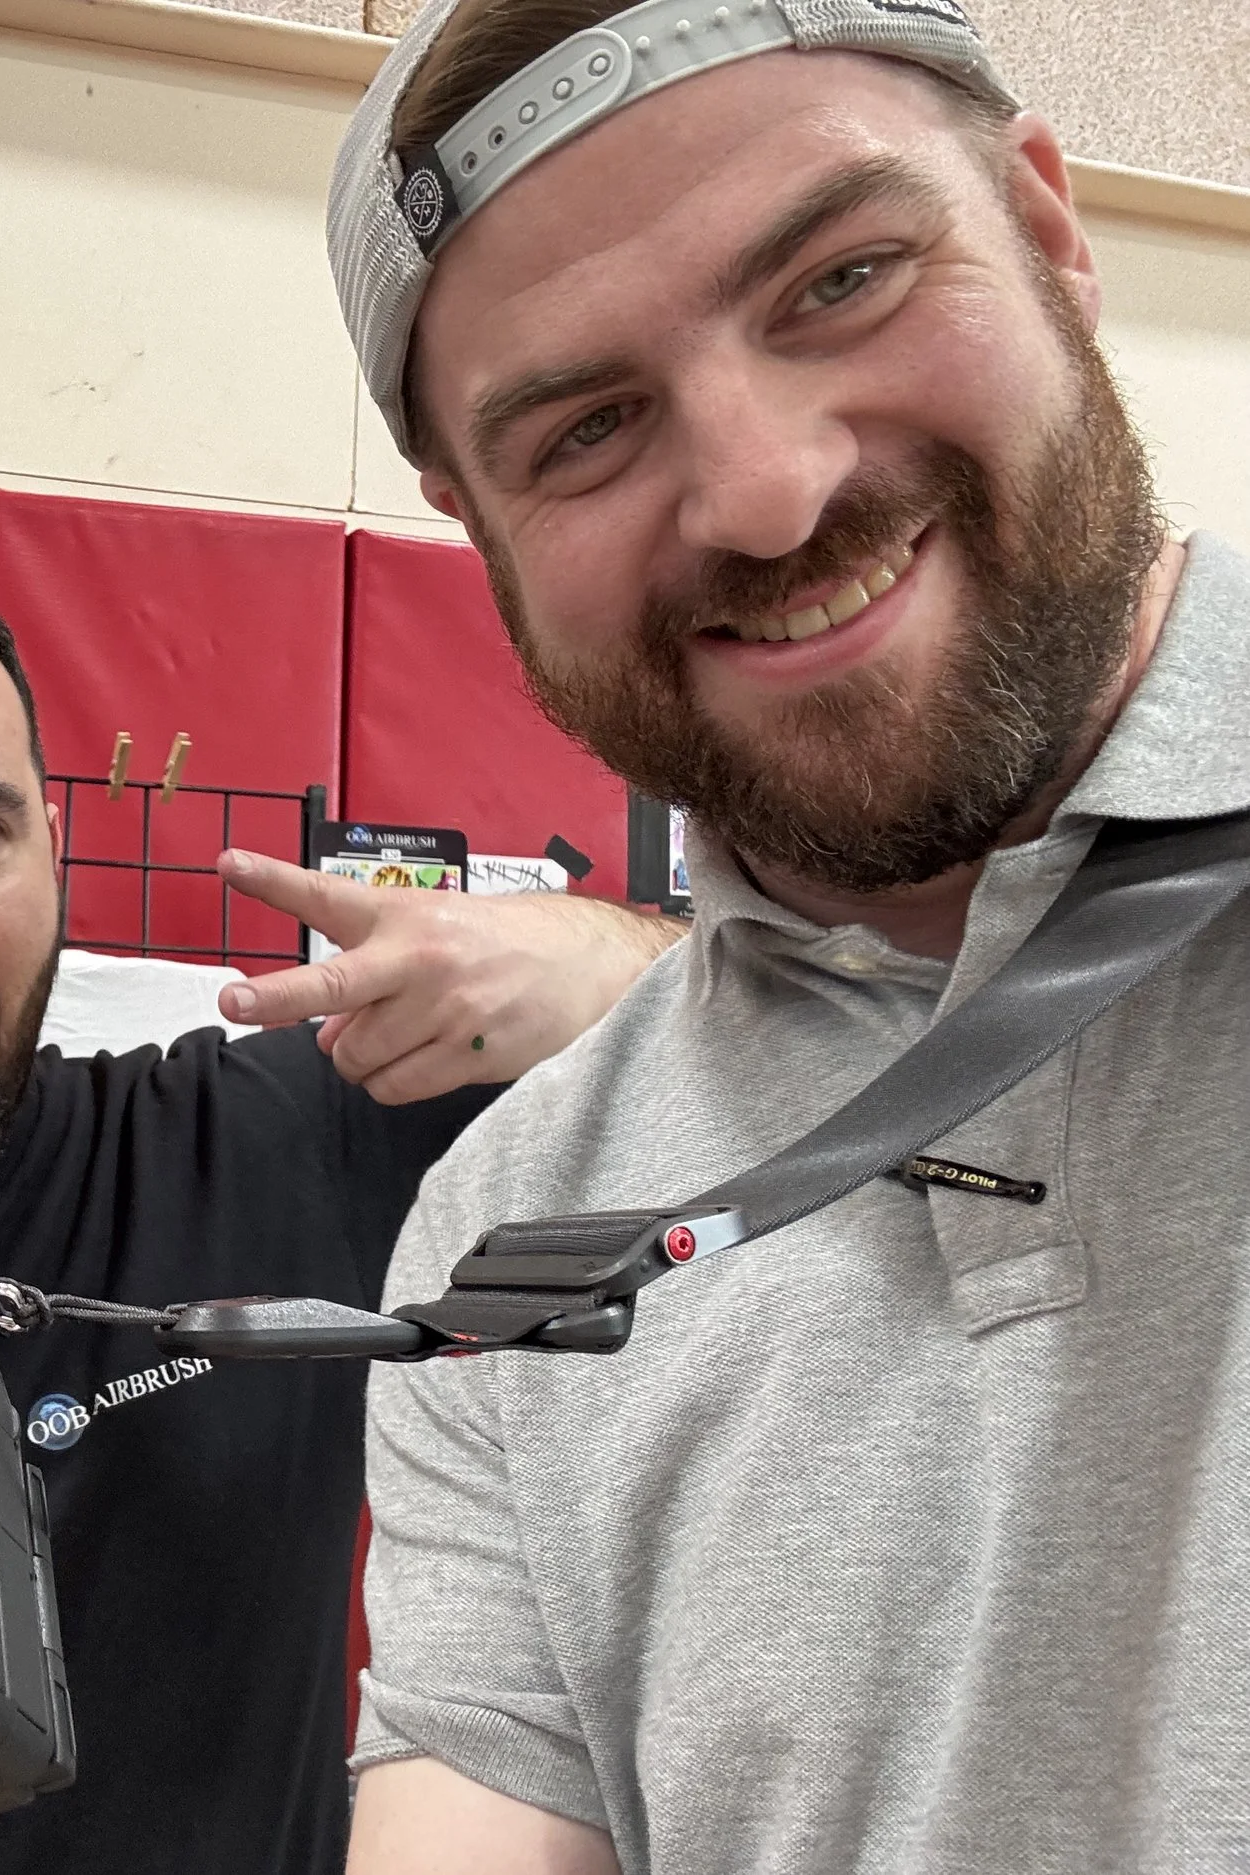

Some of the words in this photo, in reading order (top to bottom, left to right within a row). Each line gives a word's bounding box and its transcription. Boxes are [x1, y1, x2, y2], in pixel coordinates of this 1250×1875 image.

[375, 832, 437, 849] AIRBRUSH
[927, 1164, 959, 1180] G-2
[959, 1171, 997, 1189] PILOT
[27, 1405, 91, 1445] OOB
[92, 1357, 214, 1416] AIRBRUSH
